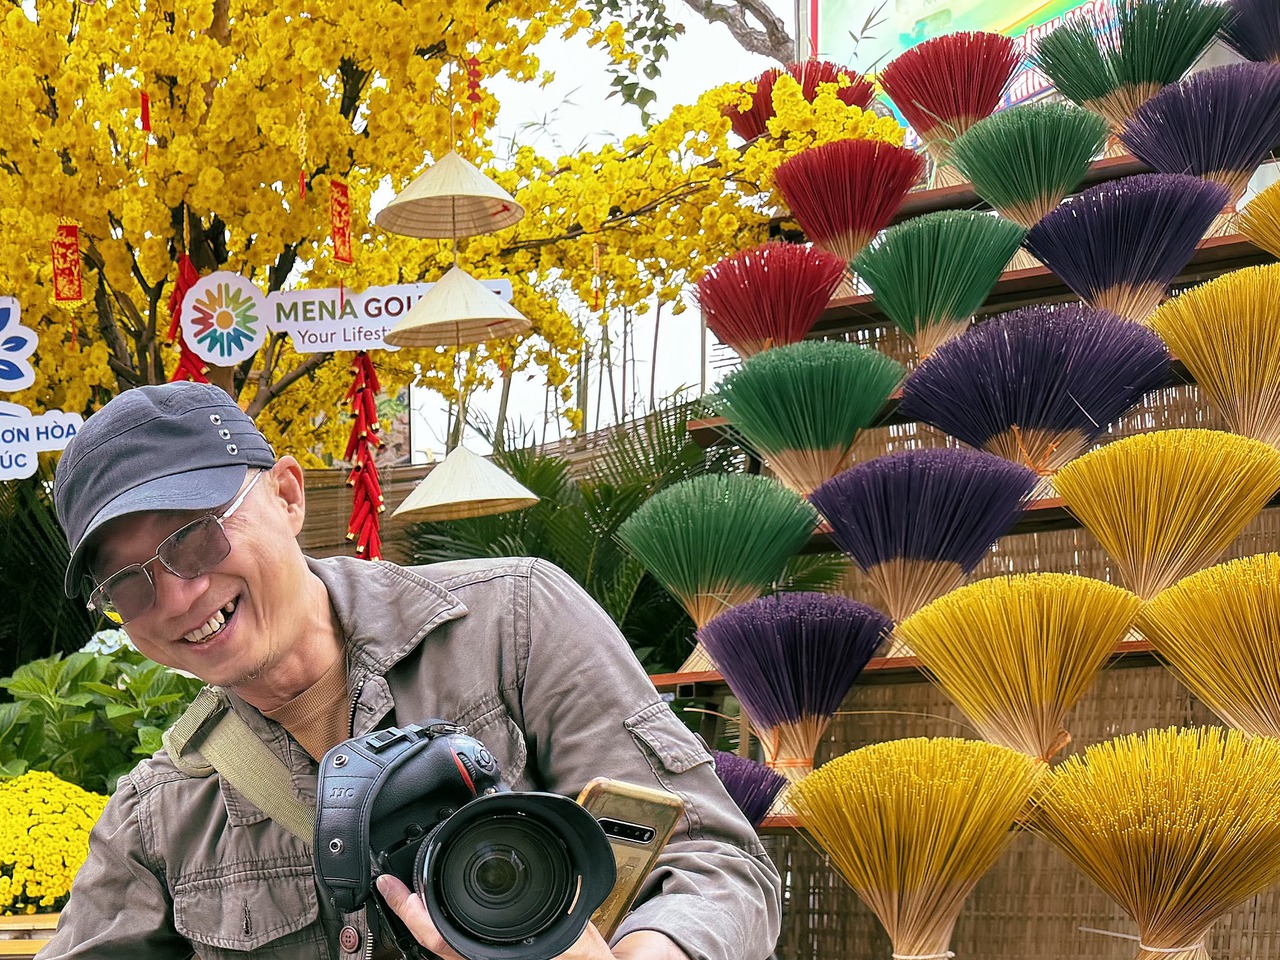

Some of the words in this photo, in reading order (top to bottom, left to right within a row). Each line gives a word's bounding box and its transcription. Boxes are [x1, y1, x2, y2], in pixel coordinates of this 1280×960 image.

[276, 298, 359, 323] MENA
[297, 329, 336, 344] Your
[36, 421, 77, 441] HÒA
[329, 787, 355, 798] JJC
